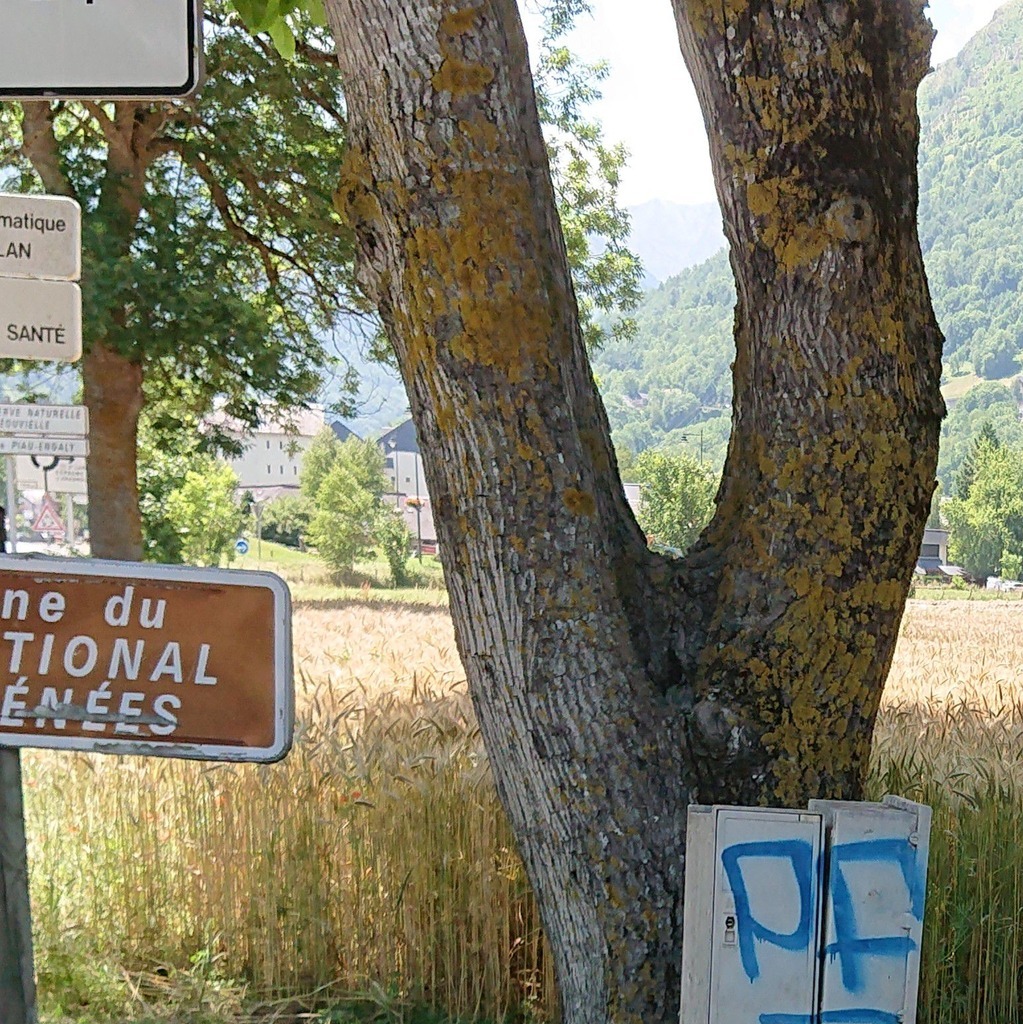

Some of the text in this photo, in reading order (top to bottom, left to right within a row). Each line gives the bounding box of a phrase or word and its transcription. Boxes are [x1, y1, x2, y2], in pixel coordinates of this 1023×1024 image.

[7, 323, 65, 344] SANTÉ
[1, 585, 167, 629] ne du
[4, 631, 218, 686] TIONAL
[0, 676, 182, 736] ÉNÉES
